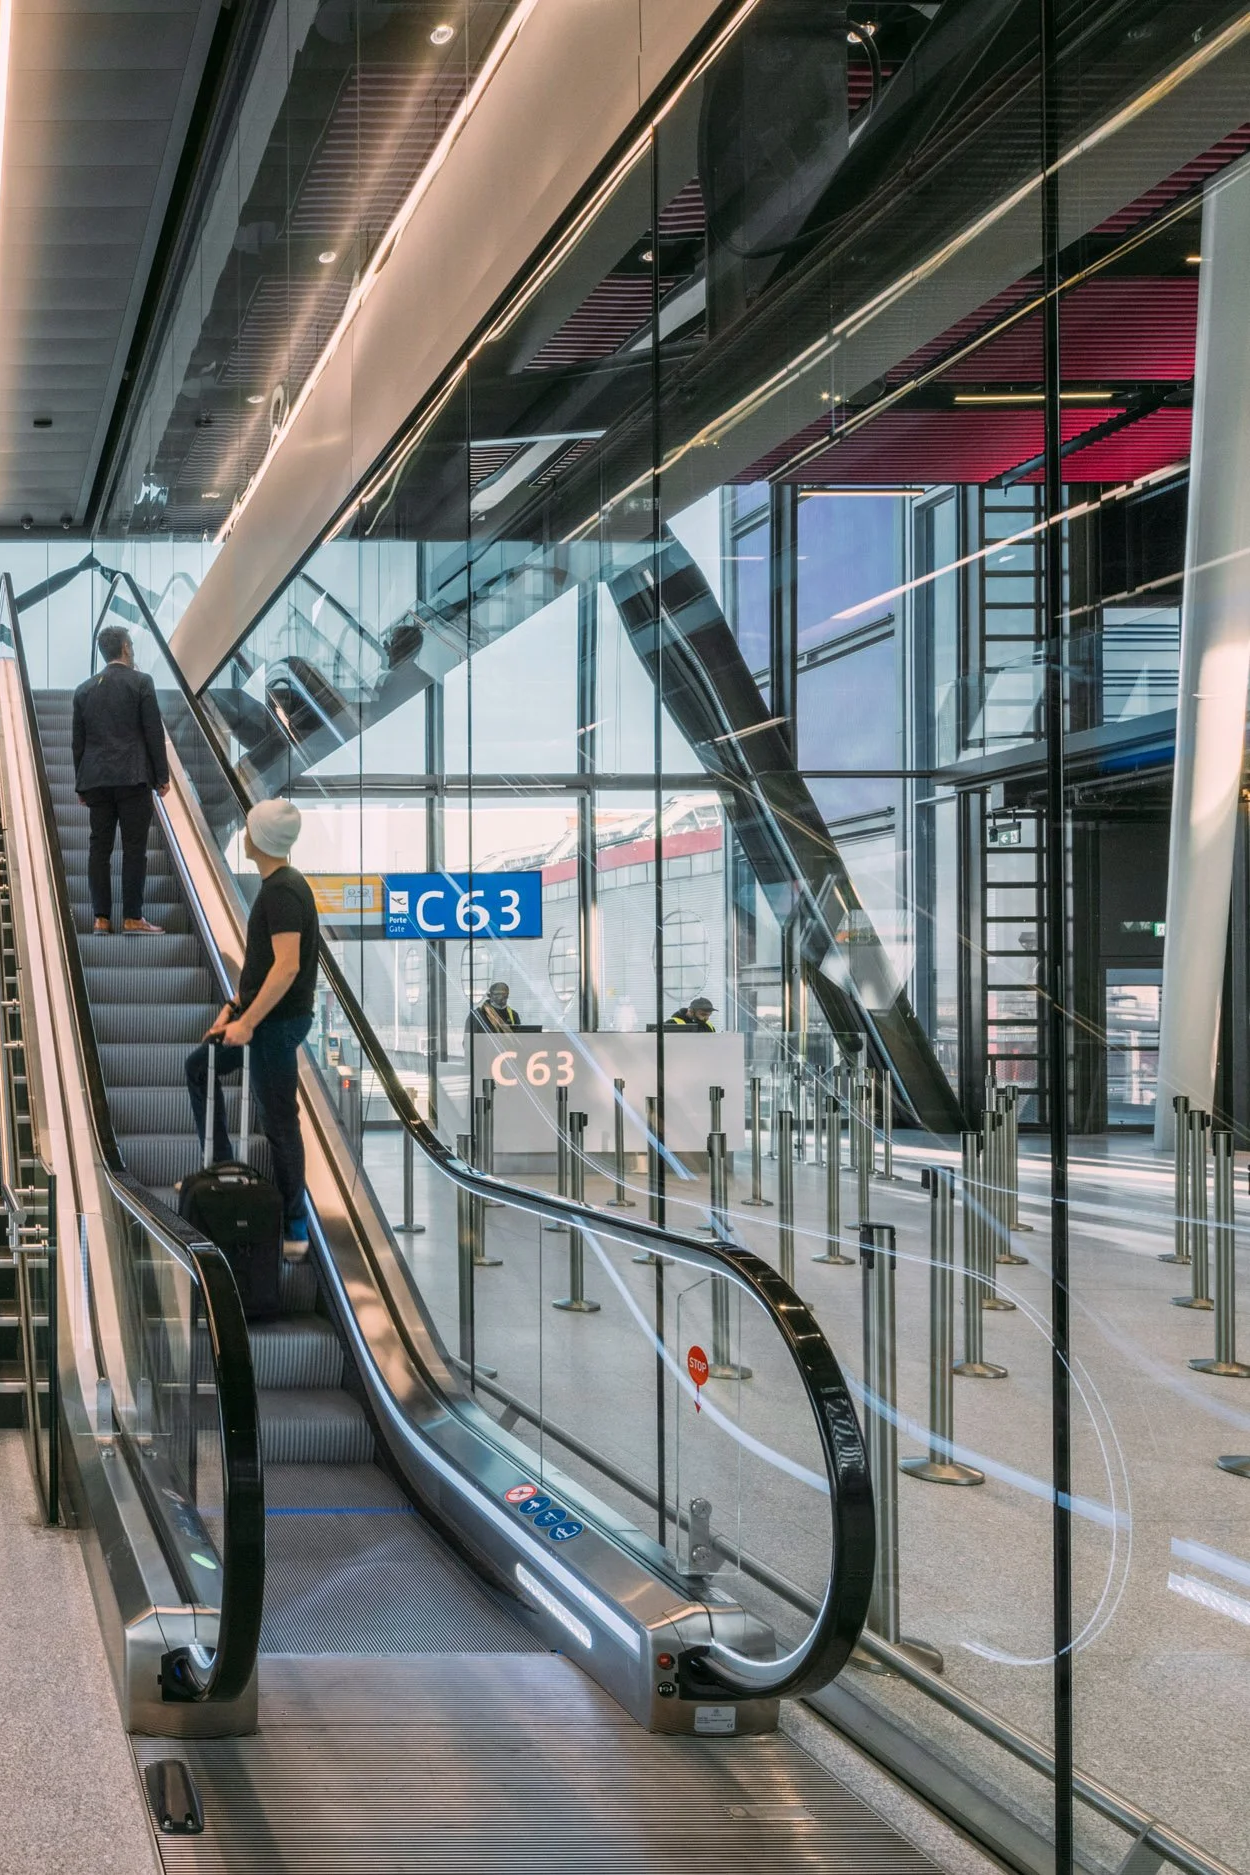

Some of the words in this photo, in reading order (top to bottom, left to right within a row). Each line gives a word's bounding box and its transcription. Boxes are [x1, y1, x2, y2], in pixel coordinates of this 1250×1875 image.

[389, 916, 408, 924] Porte
[389, 925, 405, 933] Gate
[689, 1356, 707, 1373] STOP
